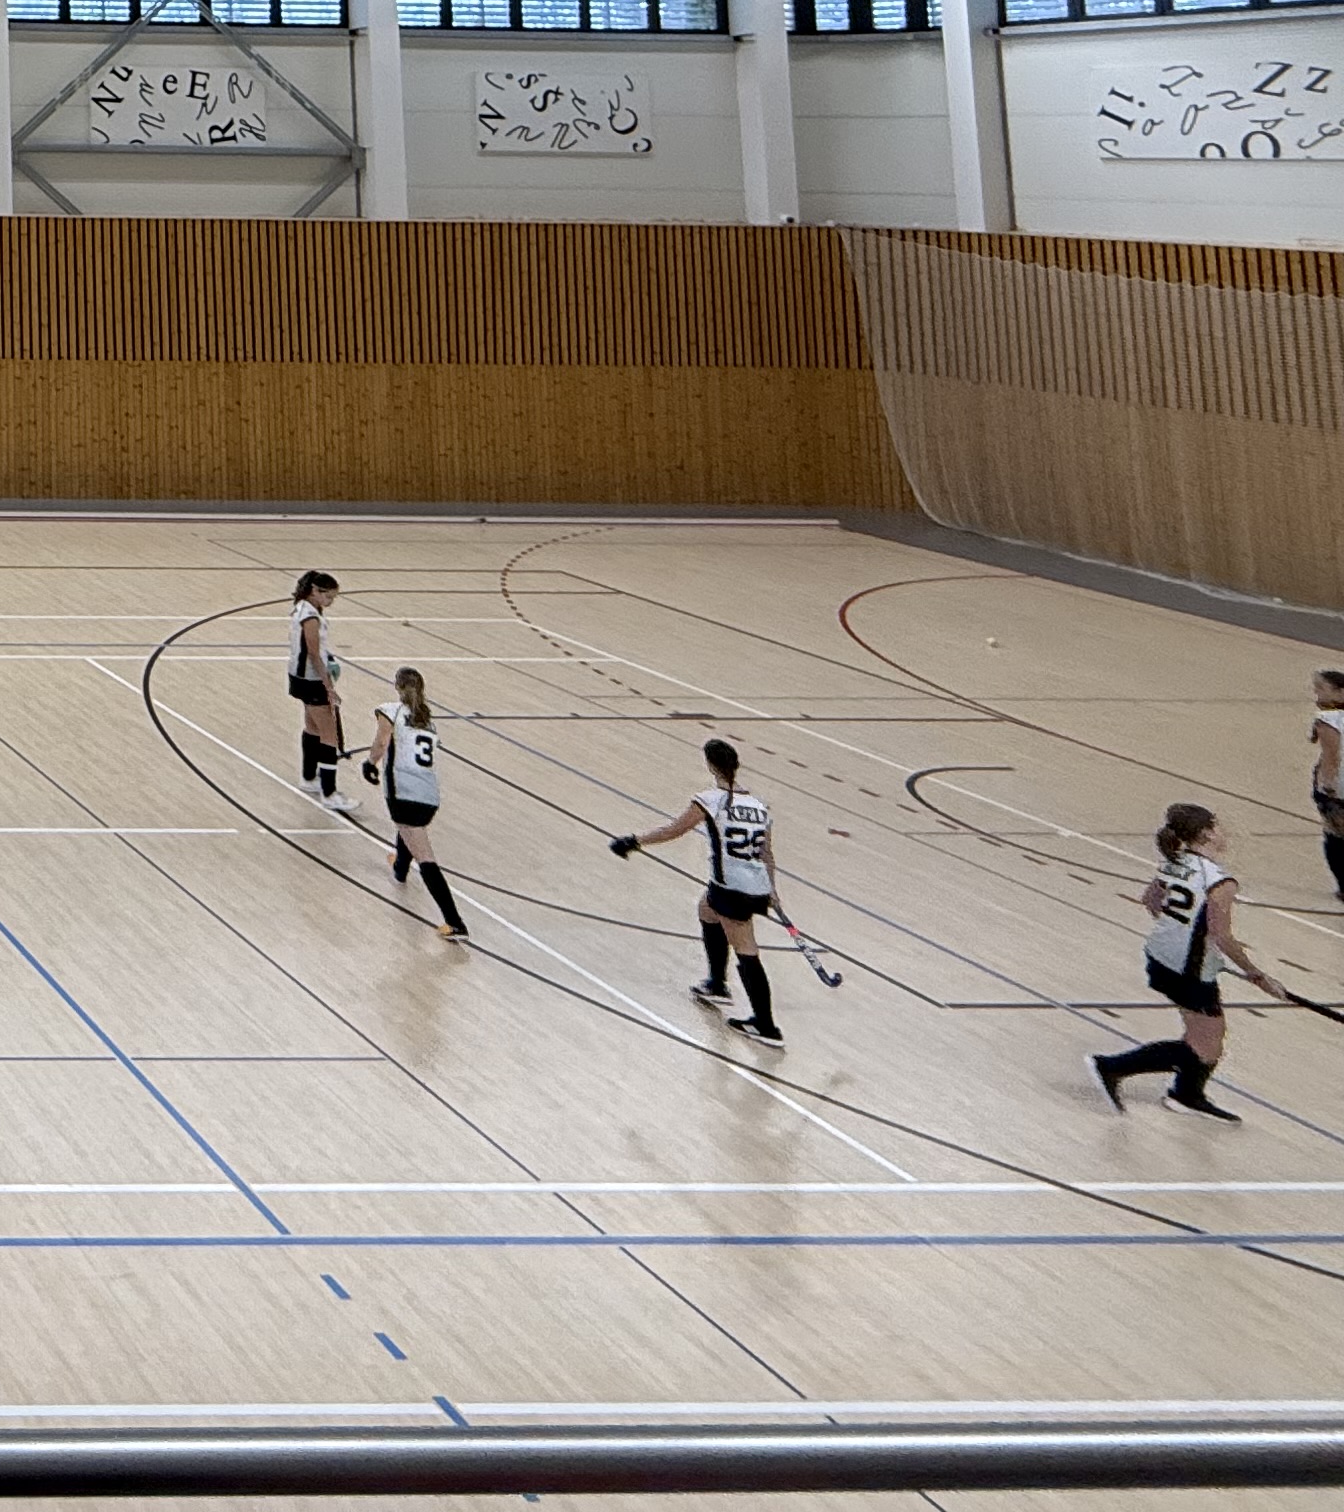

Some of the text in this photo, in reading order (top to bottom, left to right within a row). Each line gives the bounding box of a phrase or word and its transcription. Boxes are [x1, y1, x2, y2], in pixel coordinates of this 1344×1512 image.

[162, 73, 178, 94] e
[186, 70, 210, 100] E
[415, 735, 434, 767] 3
